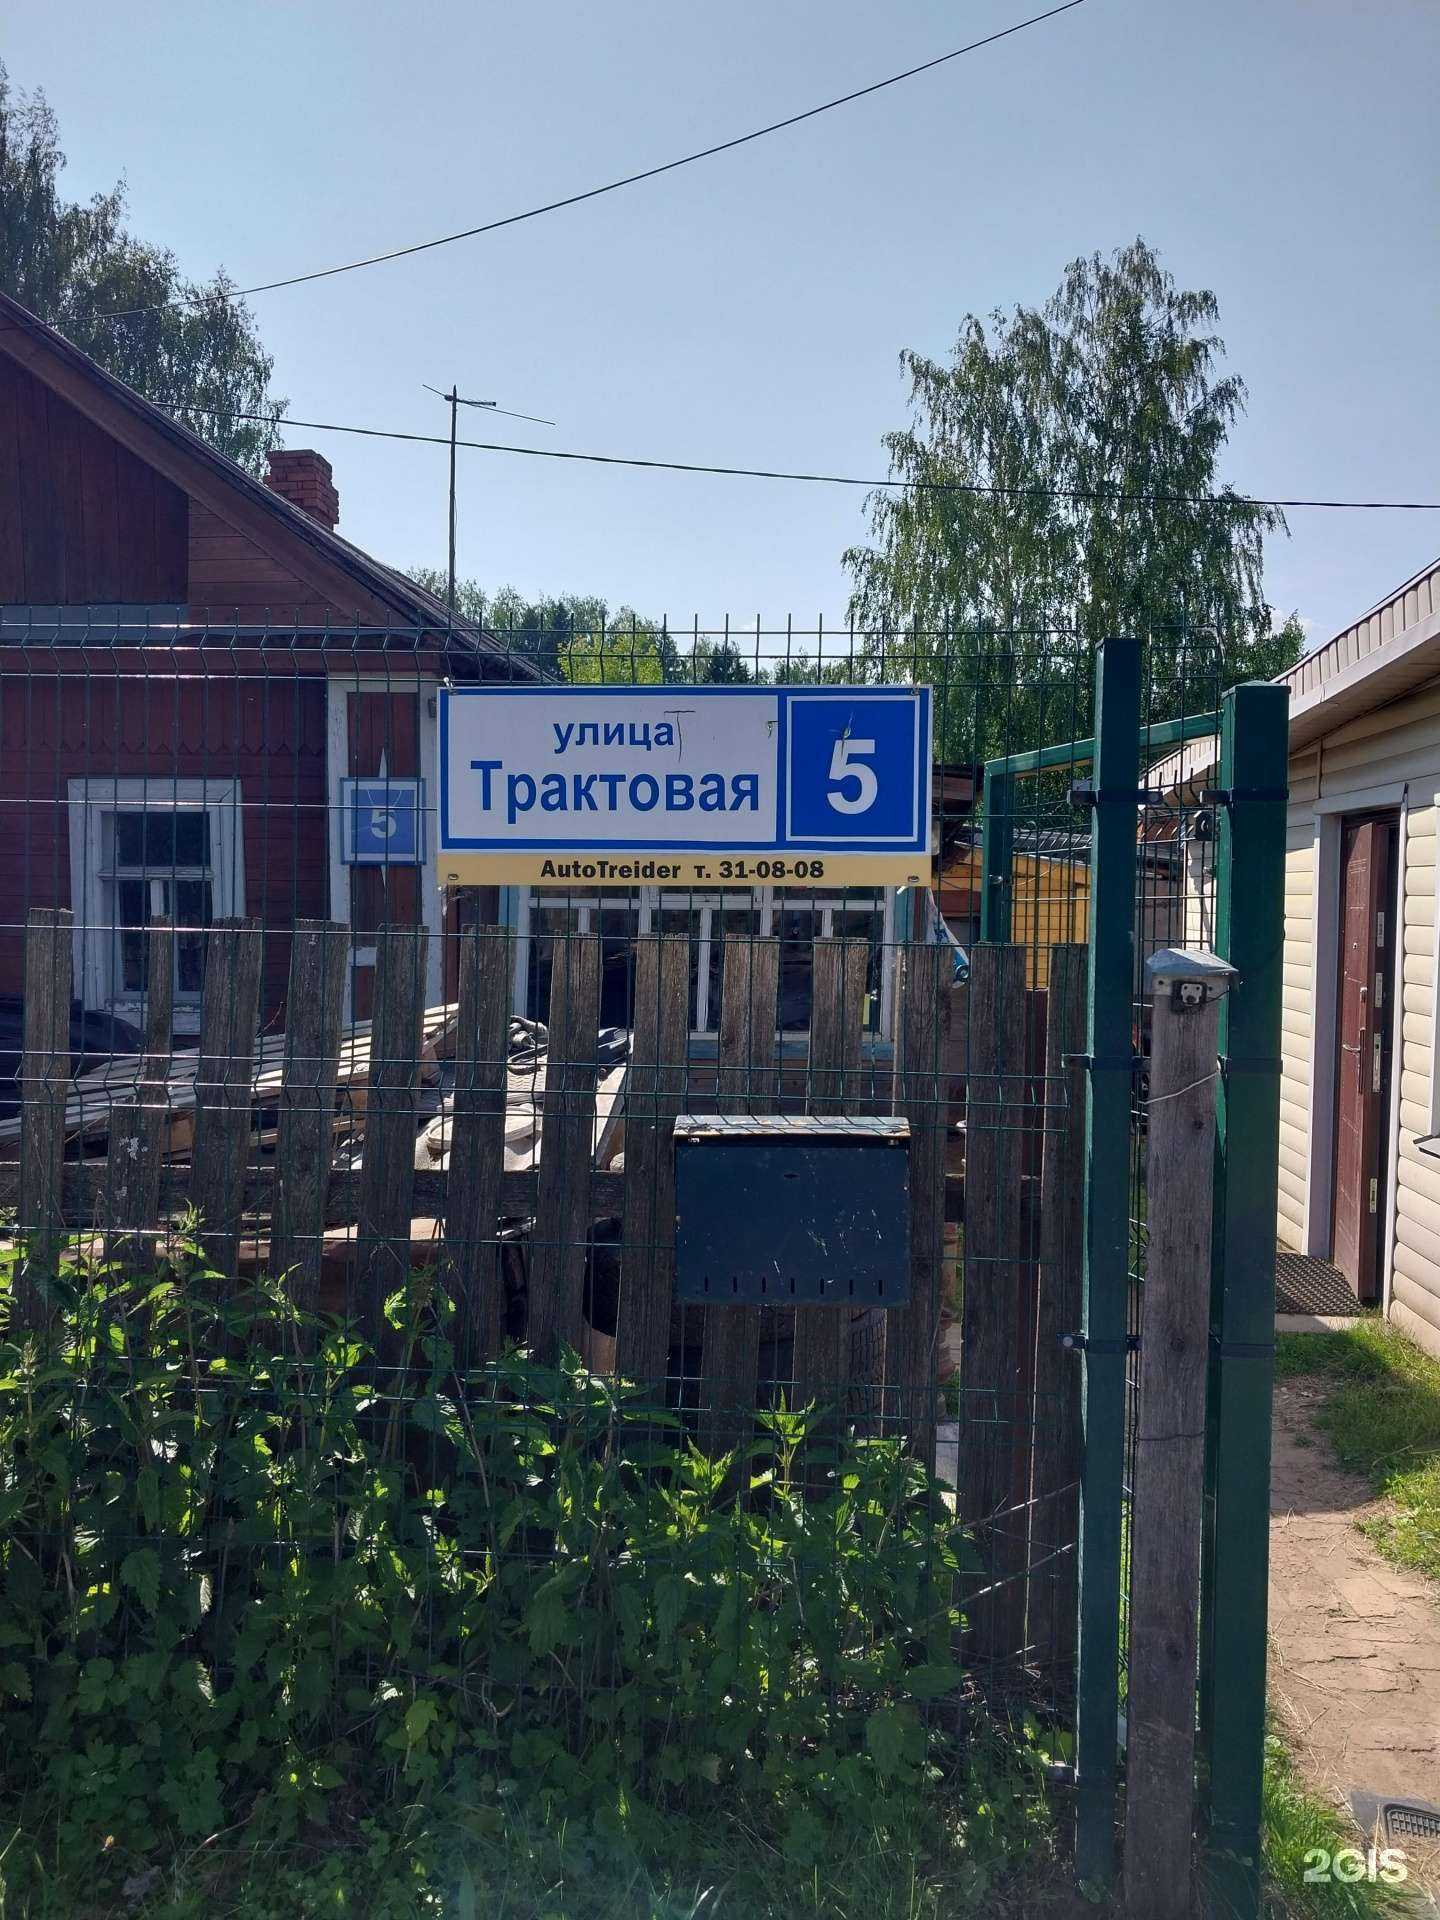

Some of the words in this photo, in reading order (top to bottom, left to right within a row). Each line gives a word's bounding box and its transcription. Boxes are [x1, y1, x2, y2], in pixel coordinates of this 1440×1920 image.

[553, 720, 674, 754] улица
[470, 759, 760, 824] Трактовая
[826, 738, 879, 815] 5
[371, 807, 397, 839] 5
[540, 859, 681, 879] AutoTreider
[719, 860, 824, 879] 31-08-08
